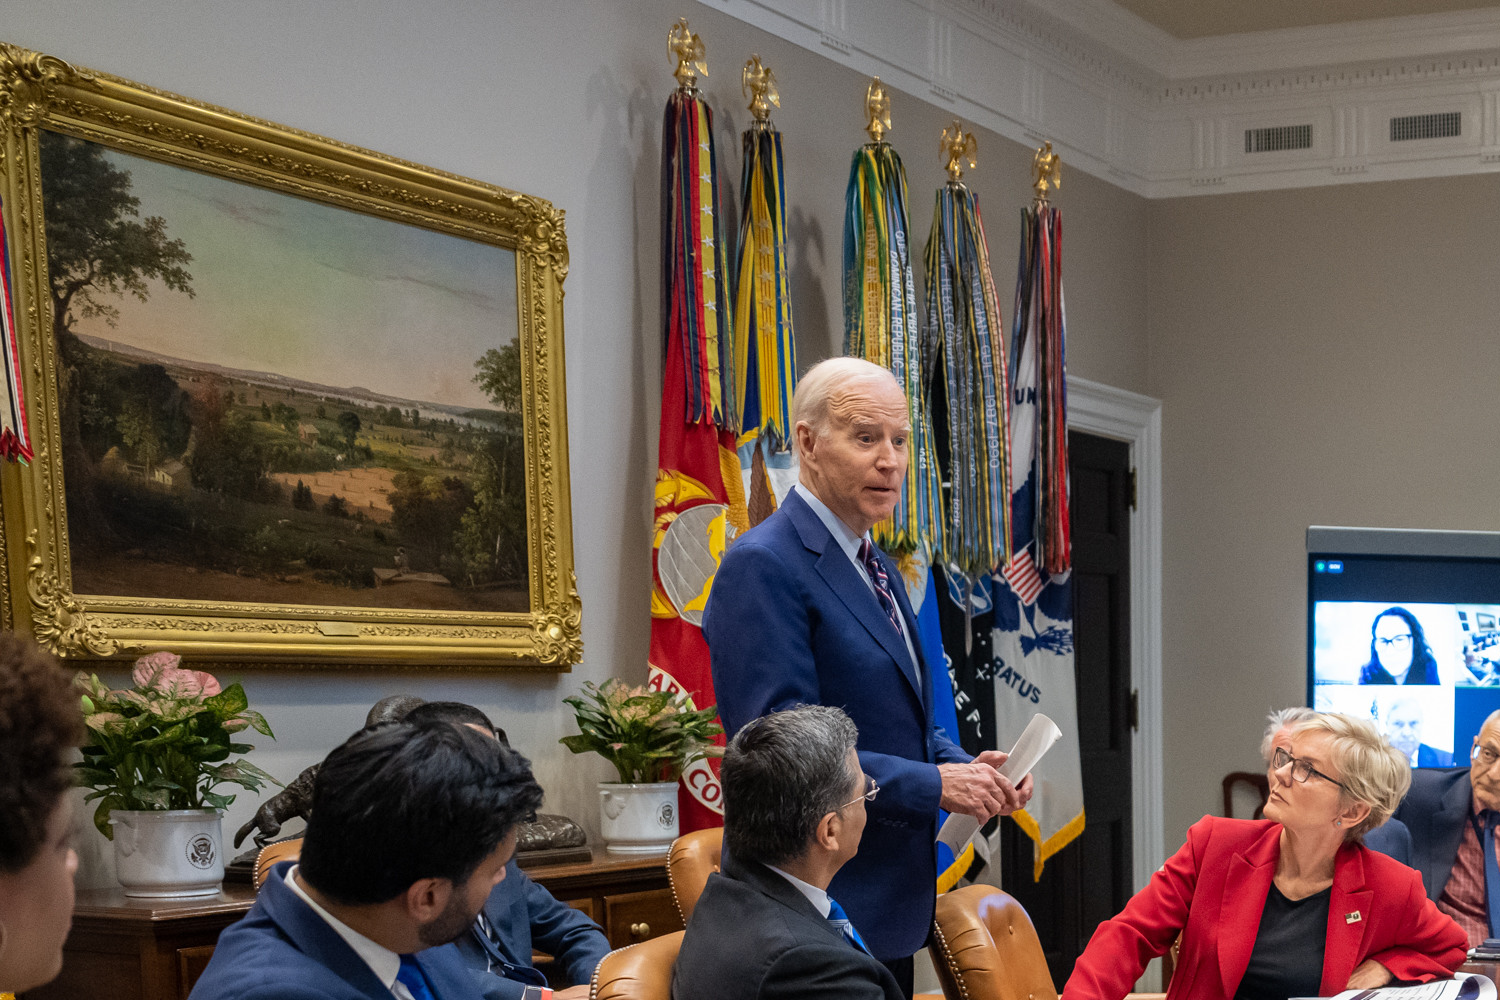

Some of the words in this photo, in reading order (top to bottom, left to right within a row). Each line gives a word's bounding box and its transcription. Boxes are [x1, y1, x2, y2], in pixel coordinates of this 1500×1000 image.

[890, 250, 902, 311] DOMINICAN
[891, 316, 904, 368] REPUBLIC
[981, 345, 994, 383] GULF
[985, 394, 999, 469] 1987-1990
